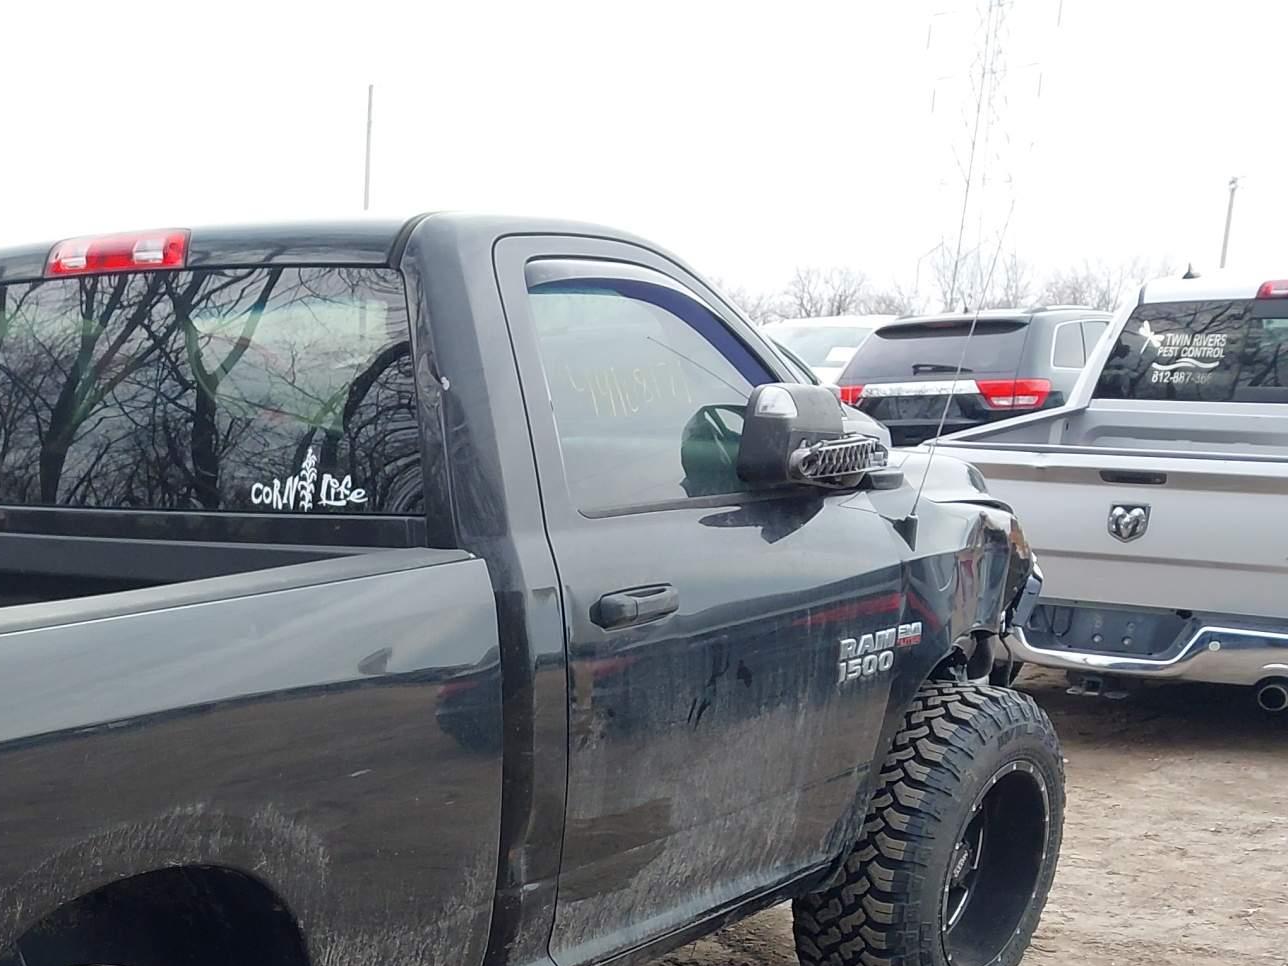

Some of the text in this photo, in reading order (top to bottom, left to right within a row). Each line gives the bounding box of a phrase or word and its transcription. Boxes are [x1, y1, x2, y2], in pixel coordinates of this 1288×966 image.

[1157, 346, 1225, 358] PEST CONTROL
[1165, 333, 1228, 347] TWIN RIVERS
[839, 627, 897, 661] RAM
[837, 650, 894, 684] 1500
